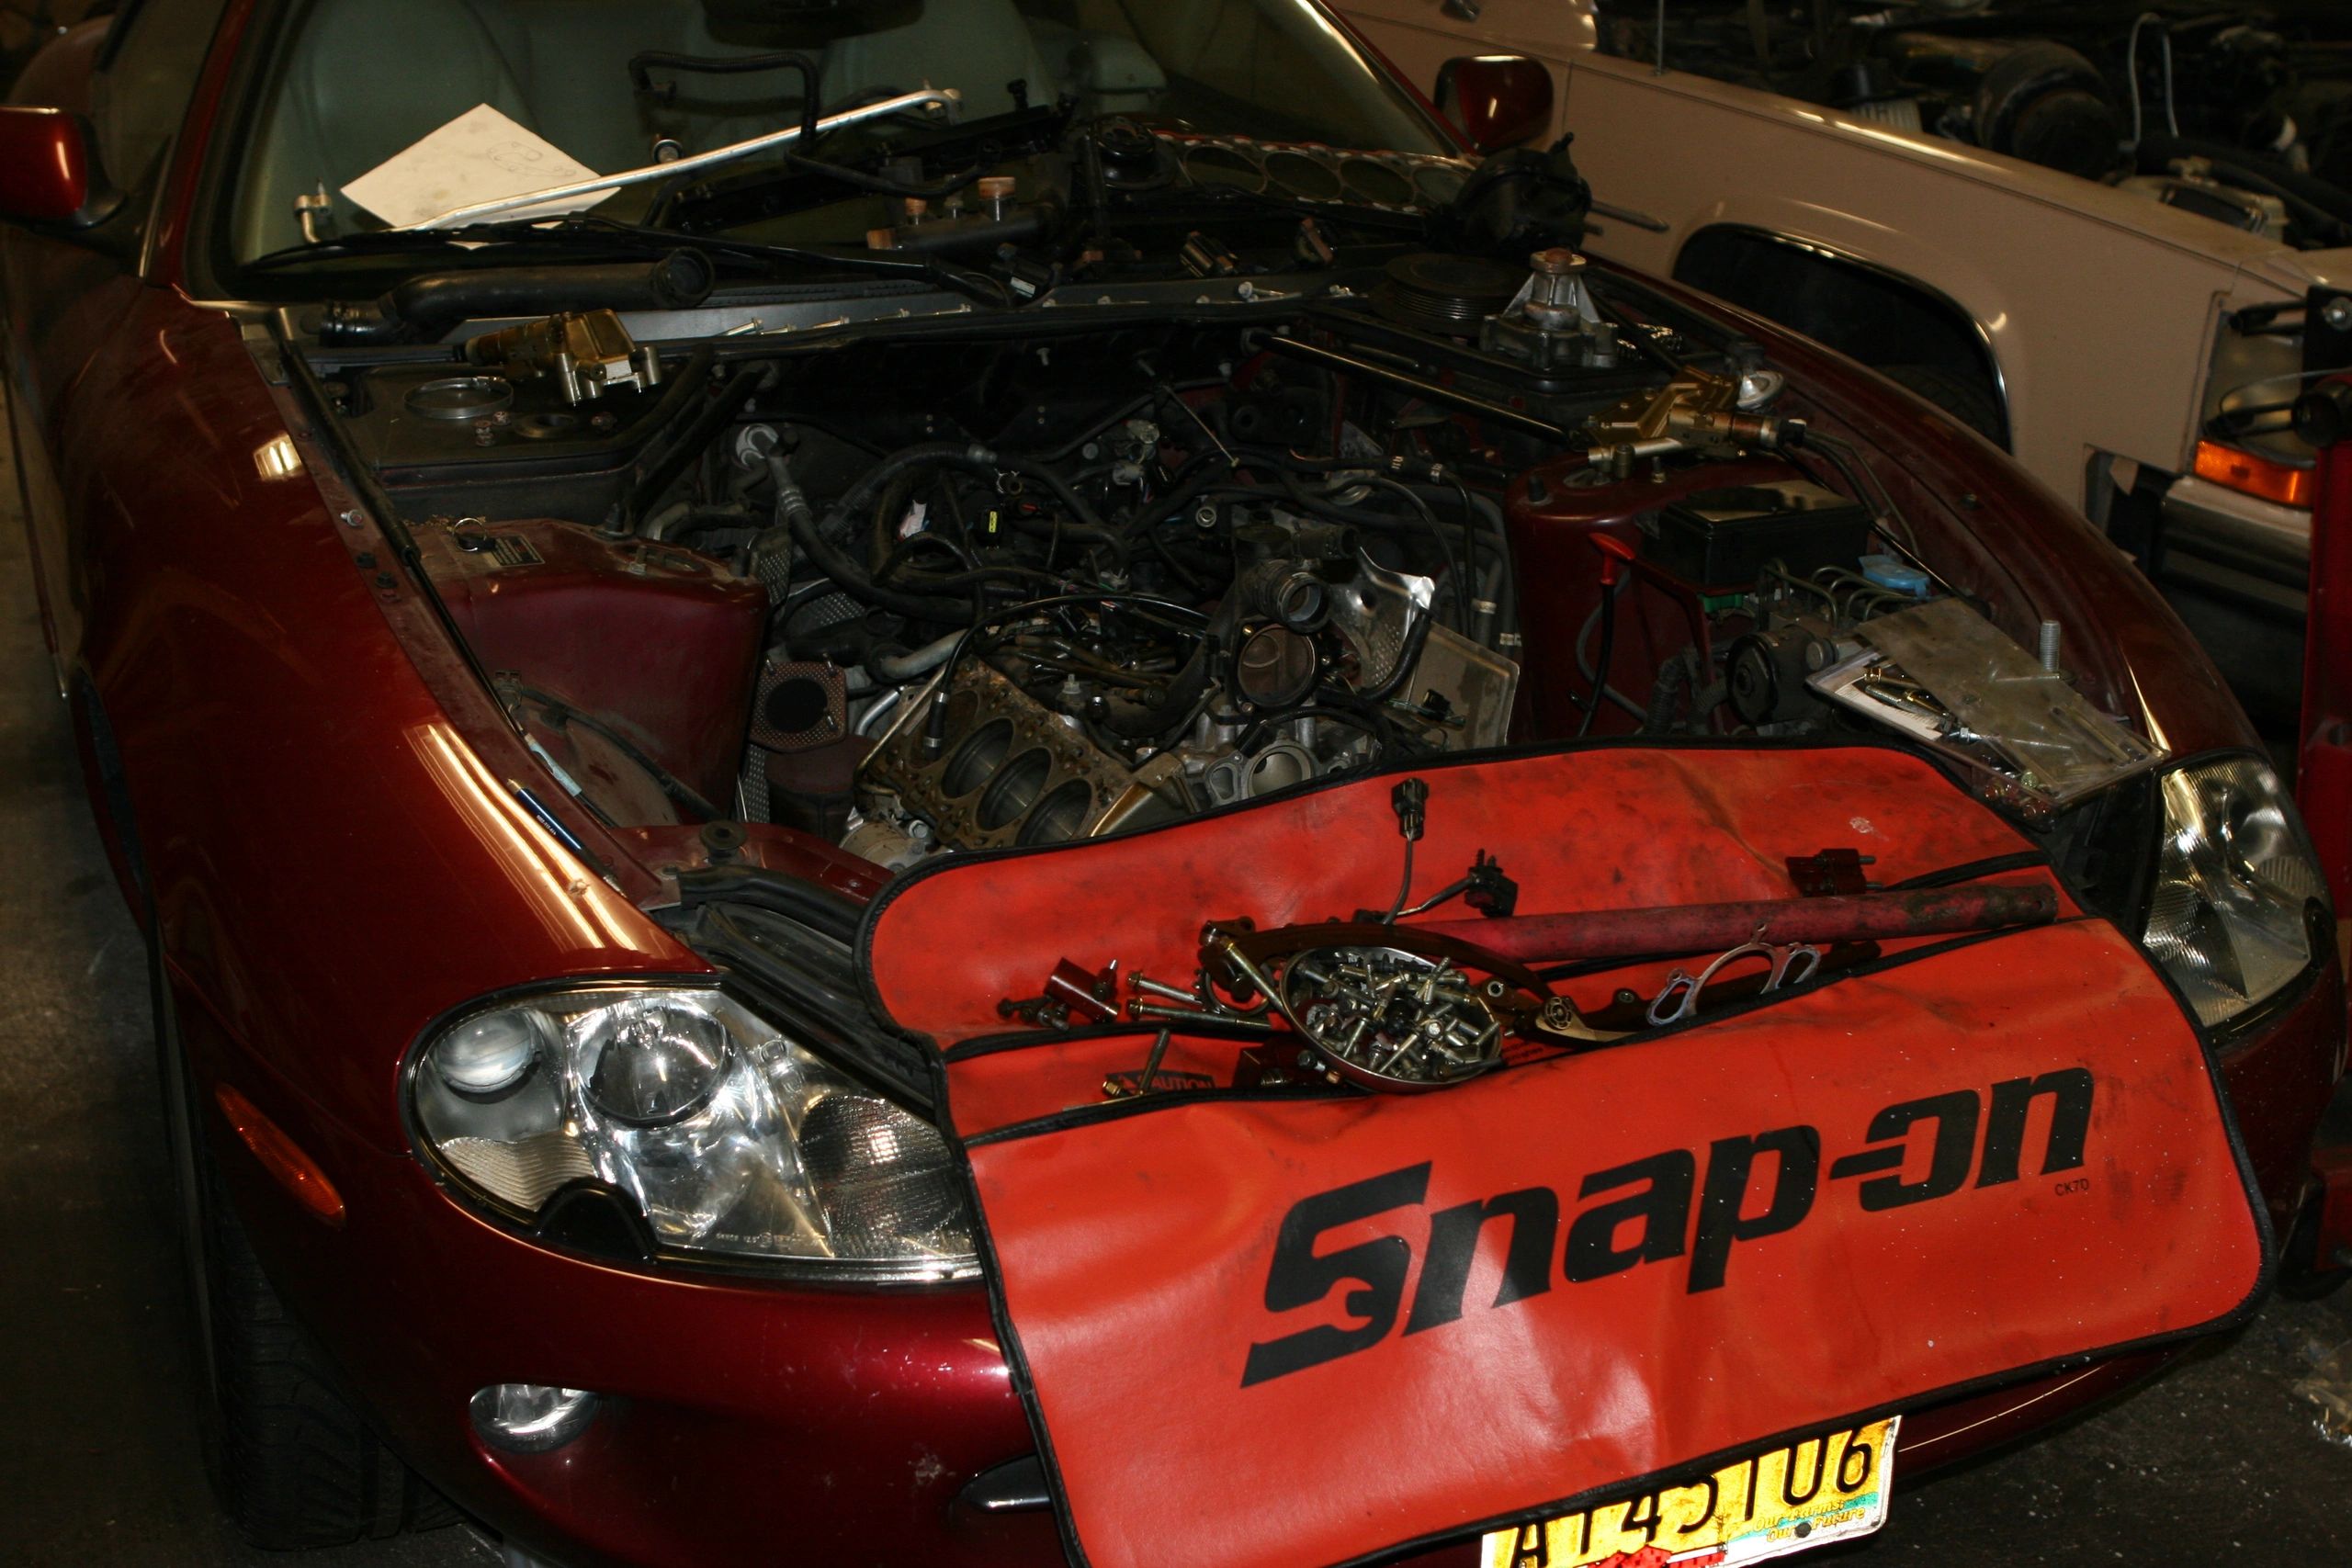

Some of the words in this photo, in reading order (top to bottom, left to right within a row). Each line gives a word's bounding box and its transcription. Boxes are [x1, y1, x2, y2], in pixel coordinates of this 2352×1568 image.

[1137, 1076, 1213, 1091] AUTION
[1240, 1066, 2094, 1389] Snap-on
[1754, 1514, 1782, 1532] Our
[1811, 1506, 1866, 1530] Future
